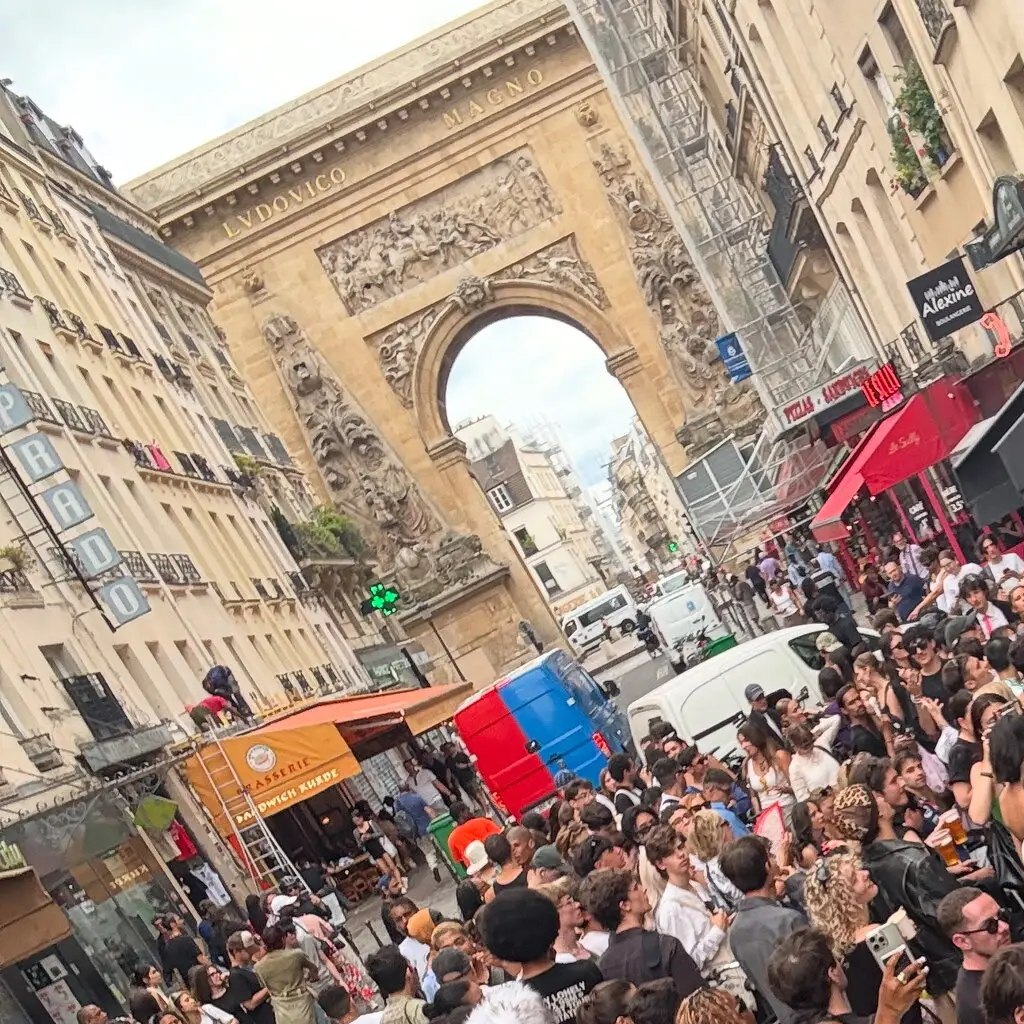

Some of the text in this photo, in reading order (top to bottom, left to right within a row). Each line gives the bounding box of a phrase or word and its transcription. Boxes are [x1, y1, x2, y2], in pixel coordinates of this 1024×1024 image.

[221, 68, 543, 239] LVDOVICO MAGNO
[922, 283, 975, 318] Alexine
[935, 304, 972, 327] BOULANGERIE
[0, 389, 141, 616] PRADO
[300, 768, 339, 796] KURDE
